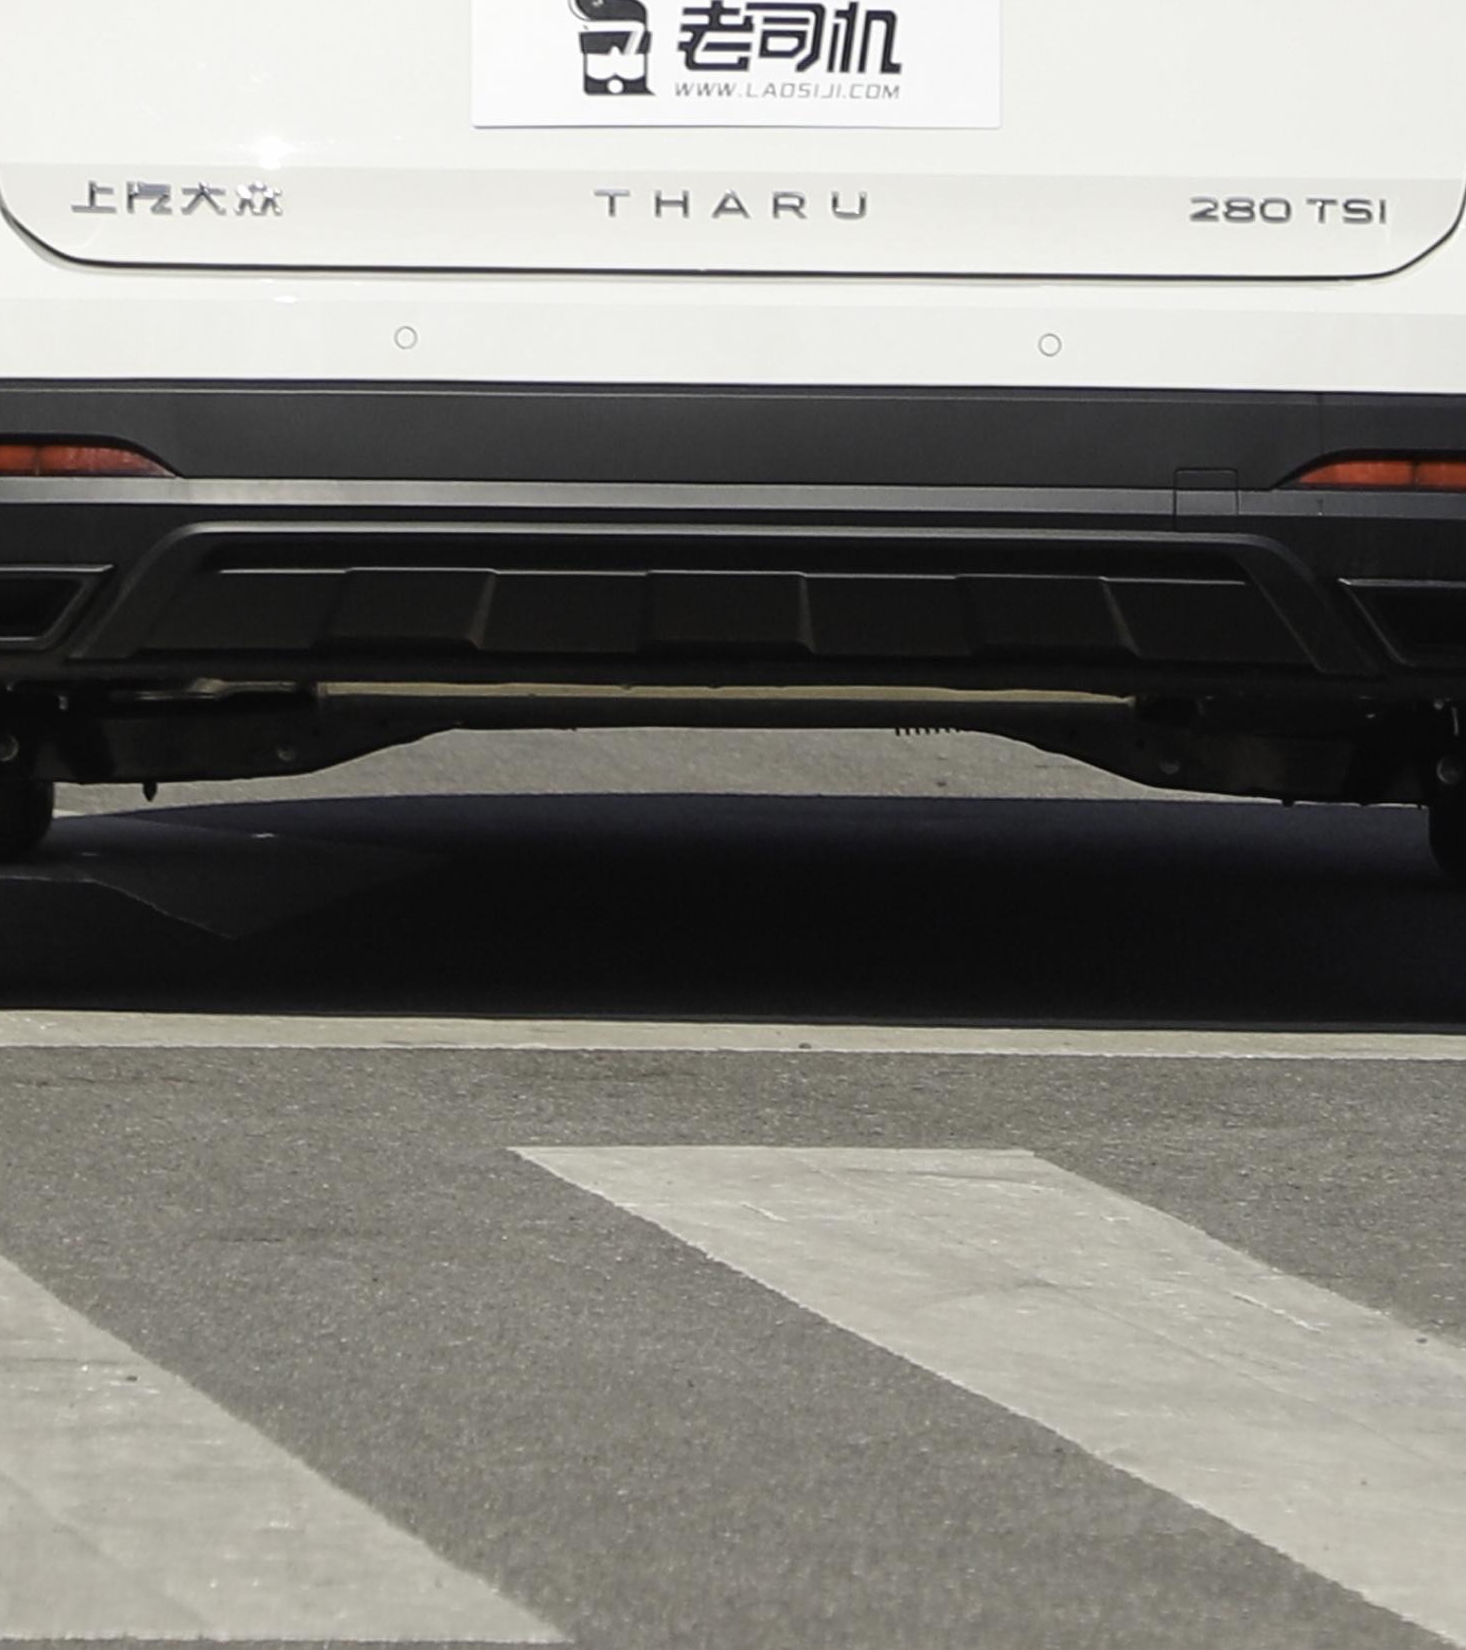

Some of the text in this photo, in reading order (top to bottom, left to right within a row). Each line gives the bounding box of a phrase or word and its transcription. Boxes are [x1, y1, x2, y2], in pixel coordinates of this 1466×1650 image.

[674, 81, 901, 100] WWW.LAOSIJI.COM
[70, 179, 283, 217] 上汽大众
[592, 188, 868, 221] THARU
[1189, 196, 1387, 225] 280 TSI
